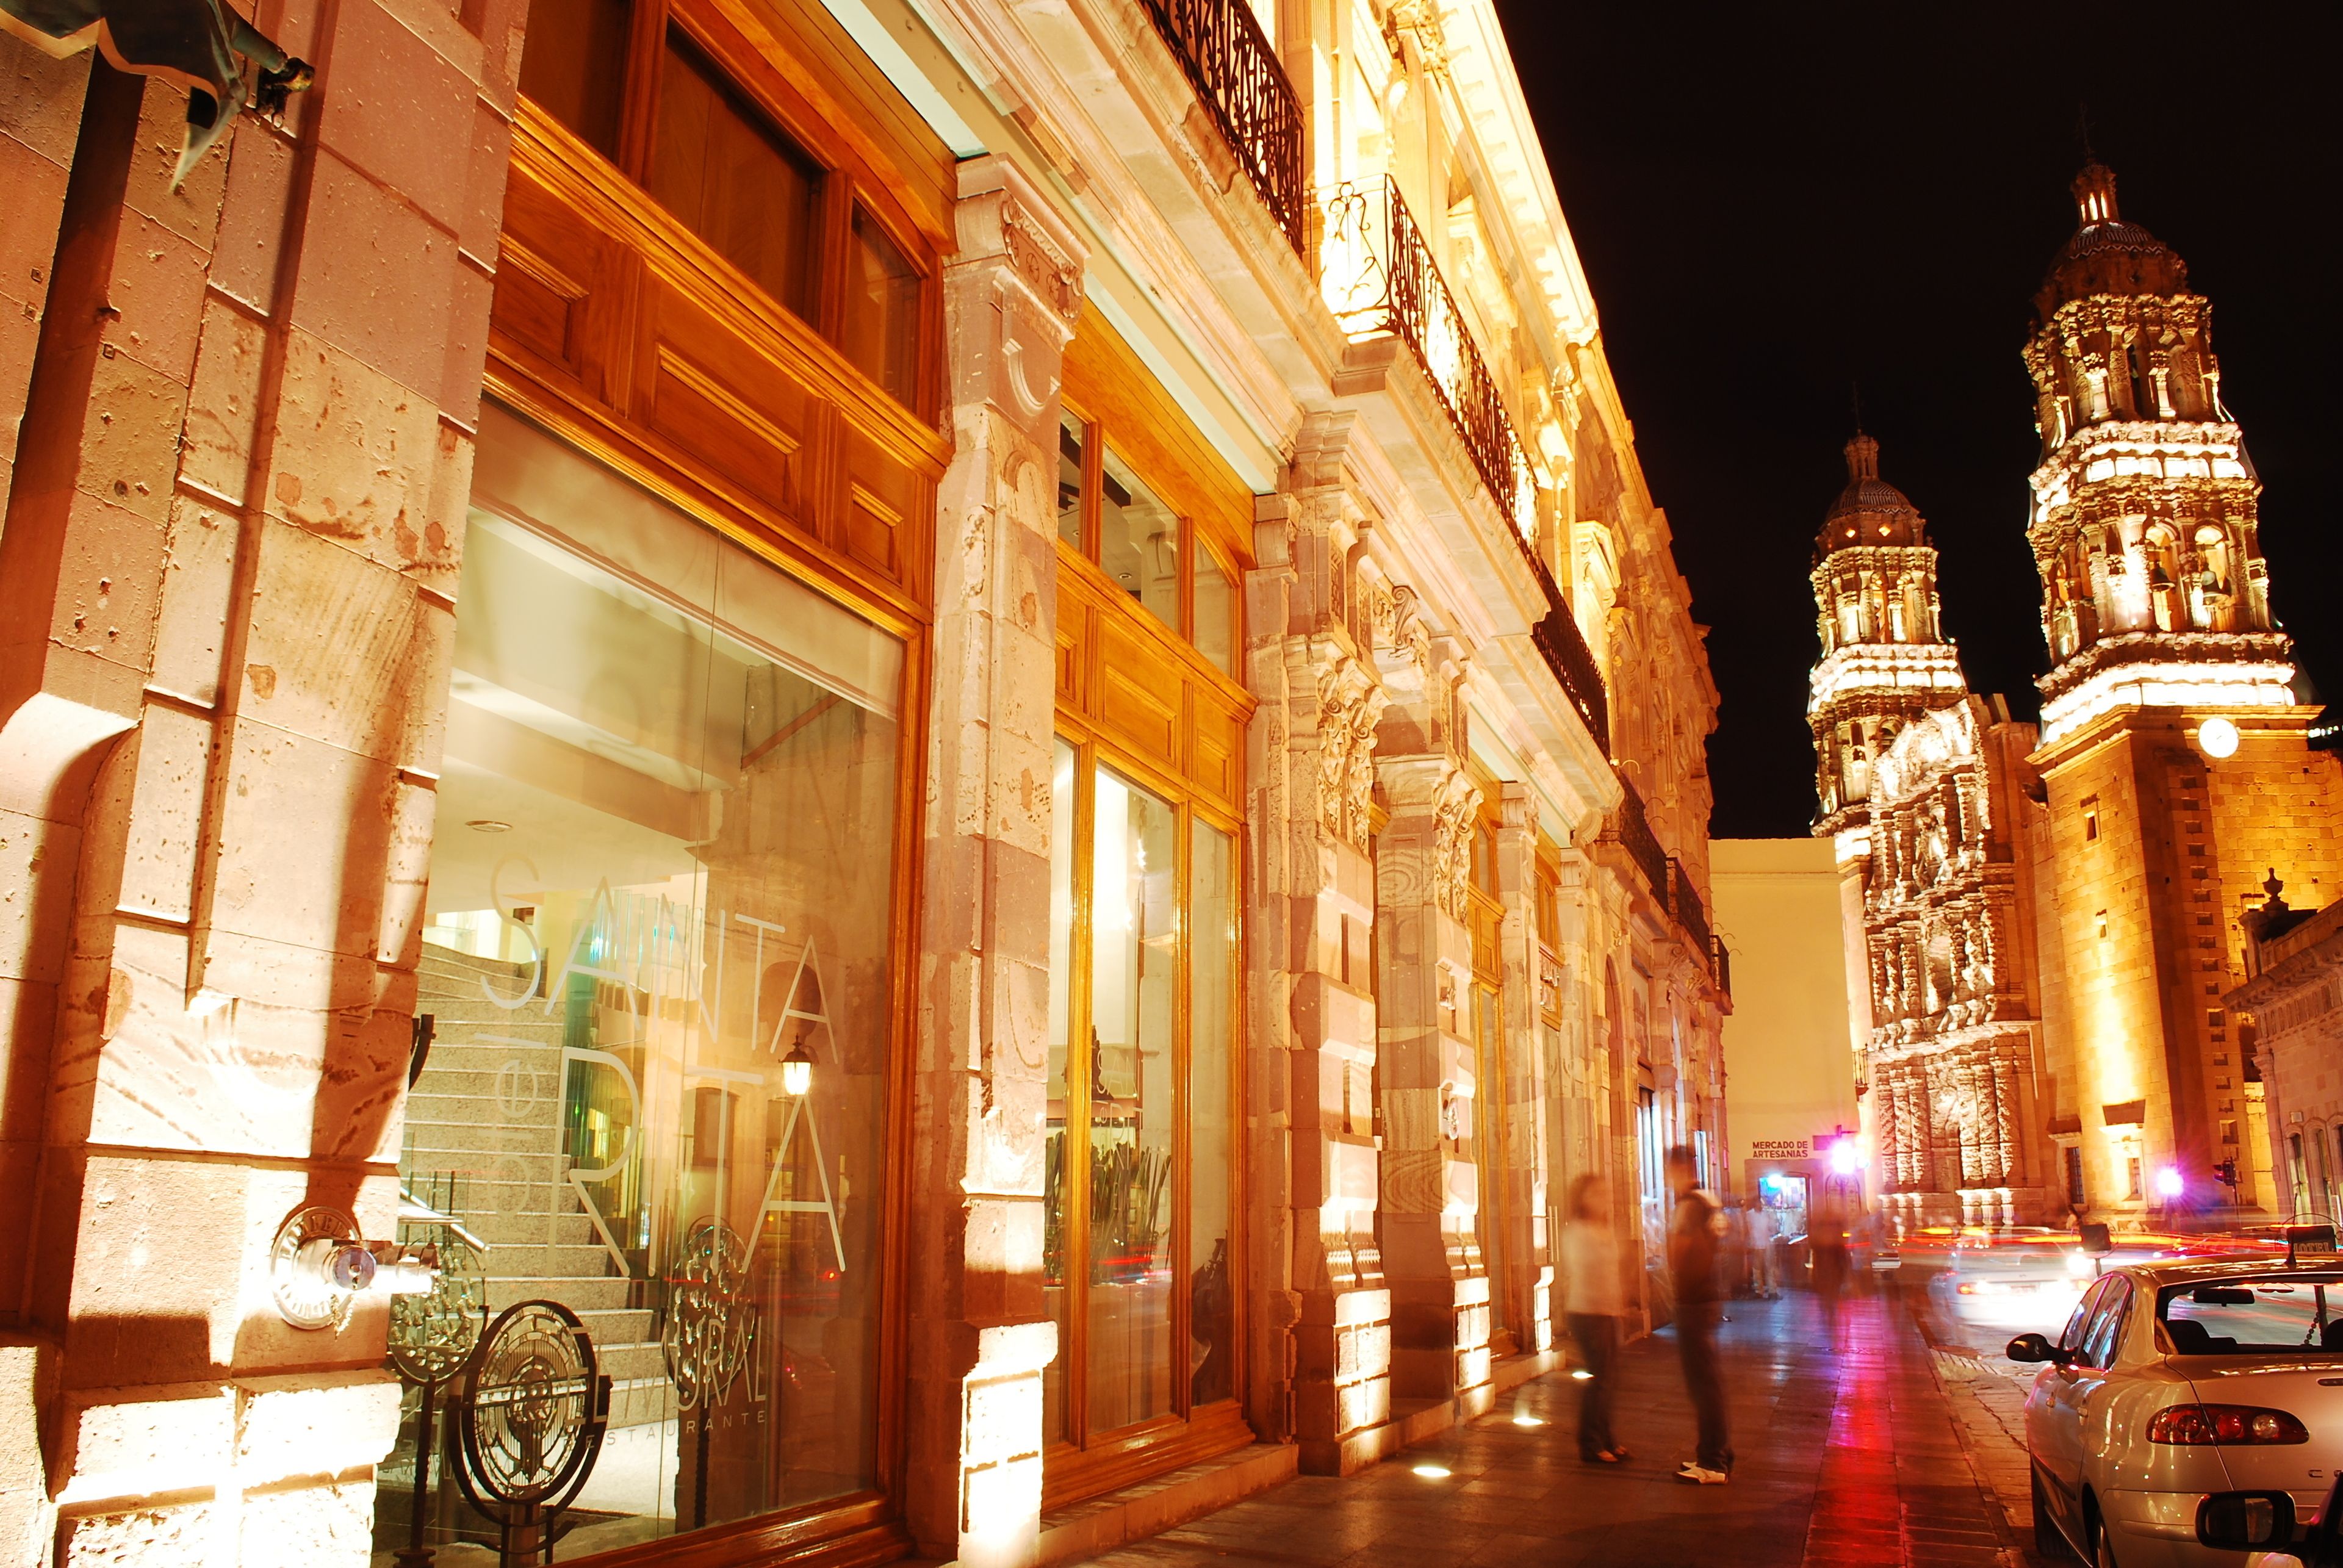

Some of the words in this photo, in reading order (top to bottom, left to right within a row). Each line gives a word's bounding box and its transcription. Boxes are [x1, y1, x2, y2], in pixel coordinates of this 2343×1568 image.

[480, 852, 838, 1064] SANTA
[454, 1032, 547, 1278] hotel
[547, 1045, 845, 1279] RITA
[565, 1326, 608, 1426] EL
[624, 1315, 766, 1412] MURAL
